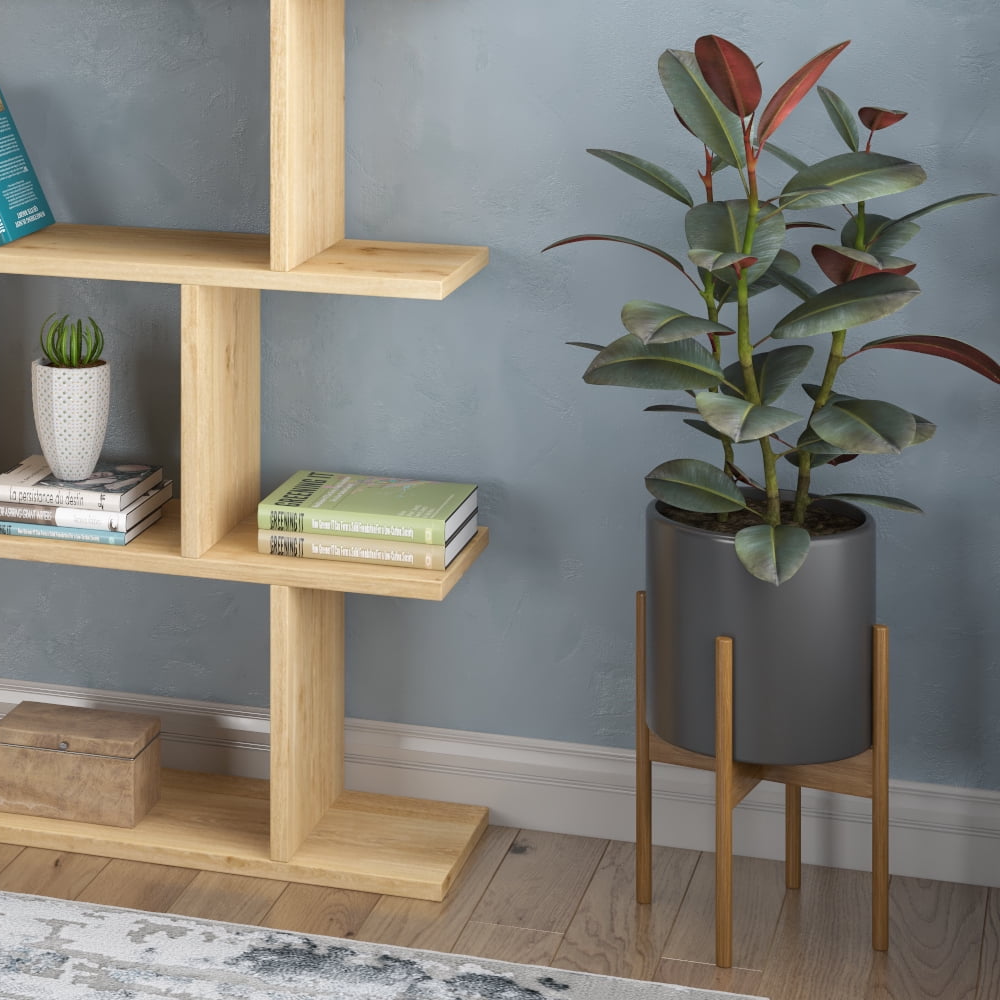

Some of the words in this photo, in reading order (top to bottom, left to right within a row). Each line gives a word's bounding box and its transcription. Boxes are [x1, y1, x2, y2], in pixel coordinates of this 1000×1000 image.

[18, 487, 54, 505] persistance
[55, 488, 64, 505] du
[65, 489, 84, 506] destin
[274, 479, 328, 507] GREENING
[306, 471, 336, 479] IT
[270, 510, 298, 533] GREENING
[298, 512, 305, 533] IT
[270, 535, 298, 557] GREENING
[298, 537, 305, 558] IT
